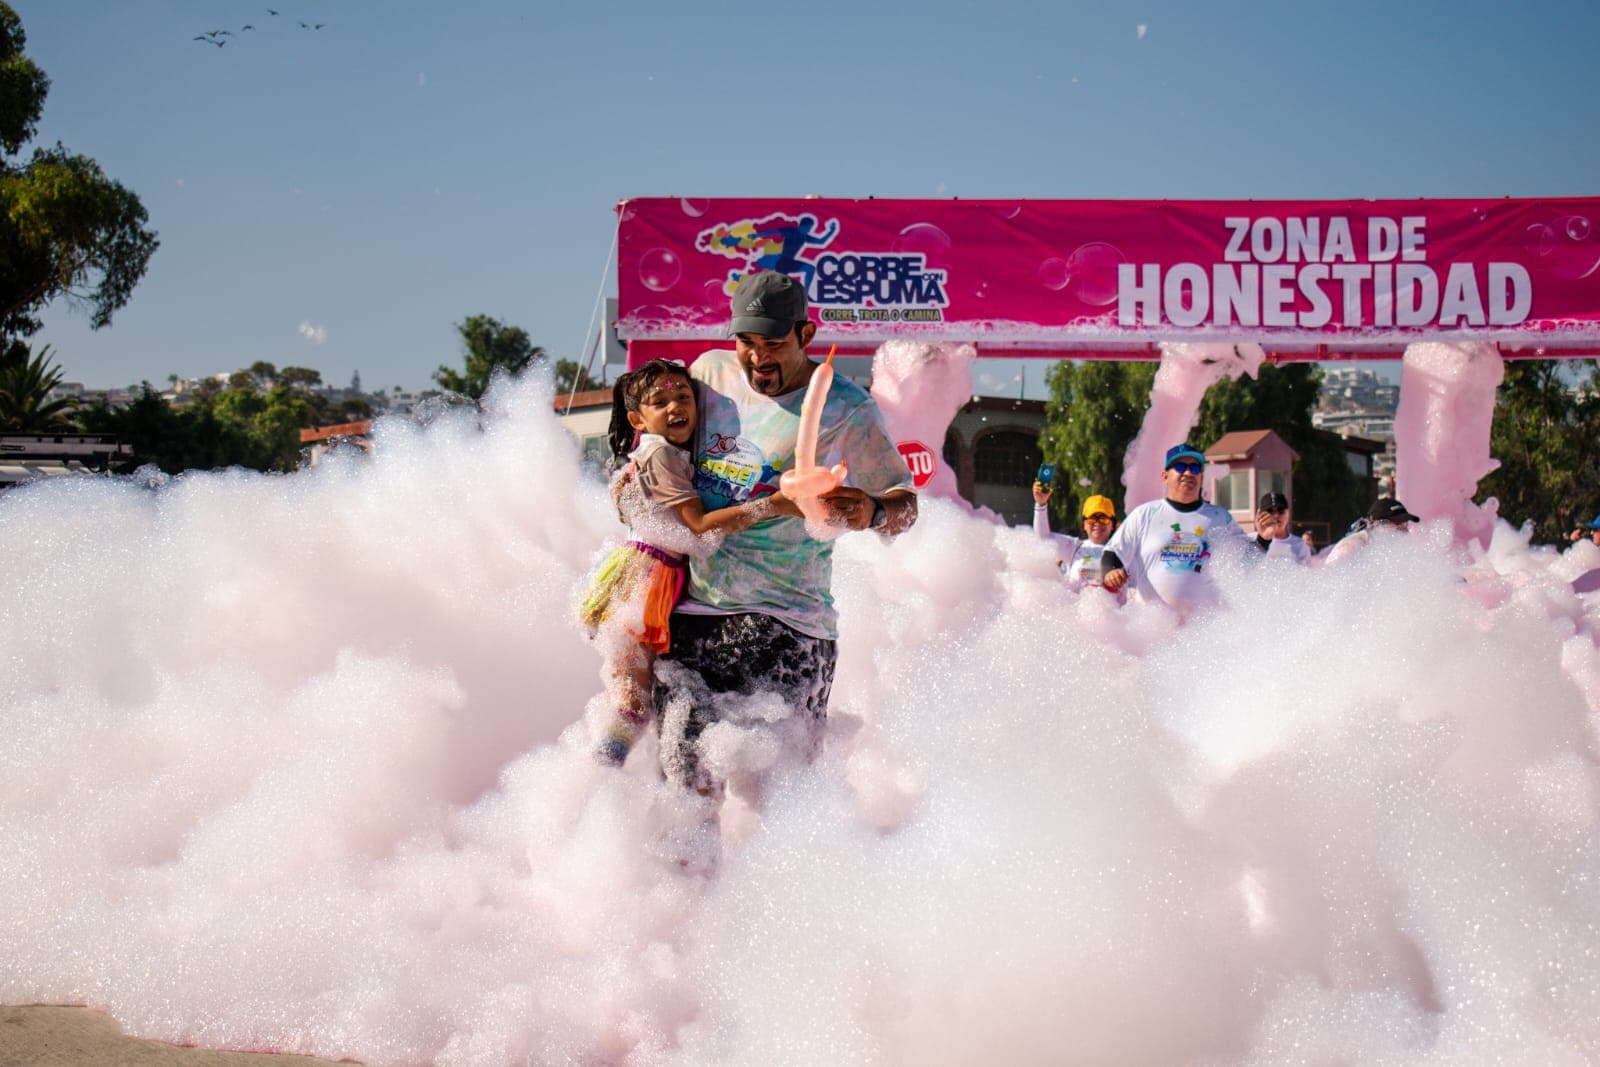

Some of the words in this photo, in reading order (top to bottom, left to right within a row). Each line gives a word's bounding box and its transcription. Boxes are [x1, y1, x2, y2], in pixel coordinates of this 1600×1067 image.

[1224, 217, 1356, 263] ZONA
[1368, 216, 1427, 262] DE
[816, 255, 922, 281] CORRE
[816, 280, 946, 304] ESPUMA
[1117, 262, 1533, 328] HONESTIDAD
[822, 309, 857, 322] CORRE,
[859, 309, 889, 321] TROTA
[890, 309, 900, 321] O
[901, 309, 941, 321] CAMINA
[903, 451, 932, 476] TO
